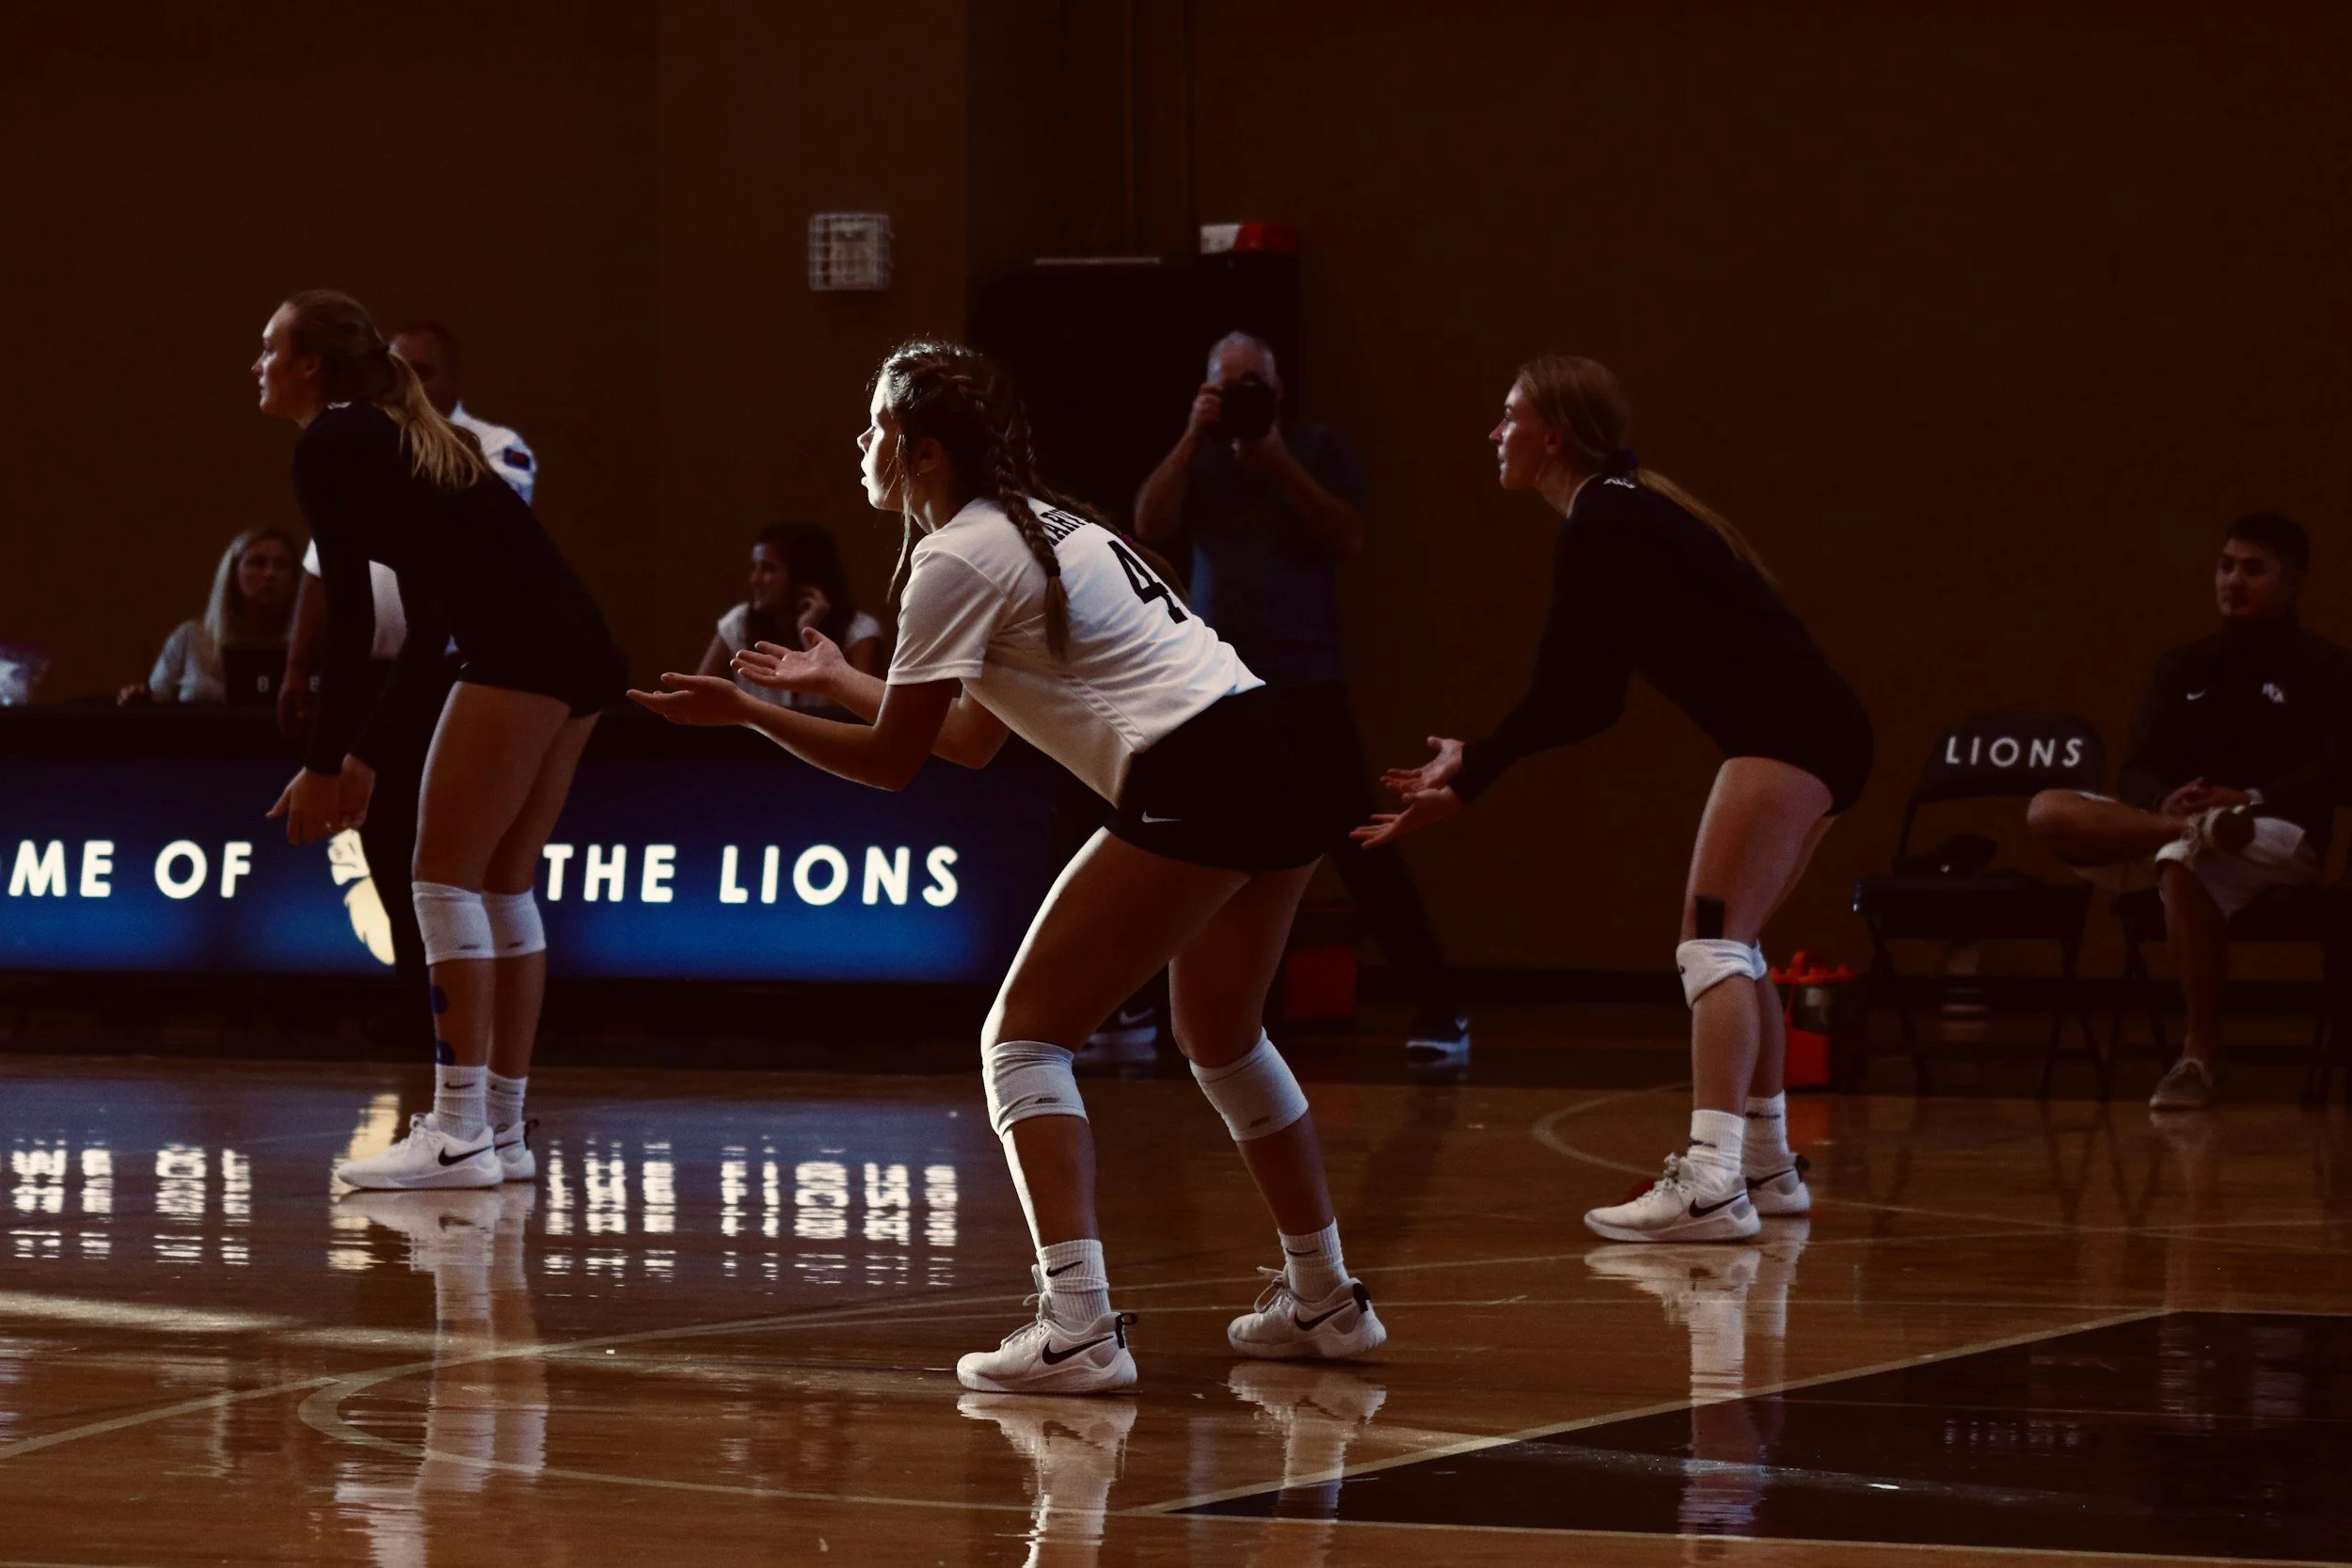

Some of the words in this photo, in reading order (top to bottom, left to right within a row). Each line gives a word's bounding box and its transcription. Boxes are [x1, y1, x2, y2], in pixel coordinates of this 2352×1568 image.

[1108, 540, 1188, 624] 4
[1944, 735, 2084, 768] LIONS
[153, 838, 254, 900] OF
[541, 843, 677, 904] THE
[718, 843, 960, 909] LIONS
